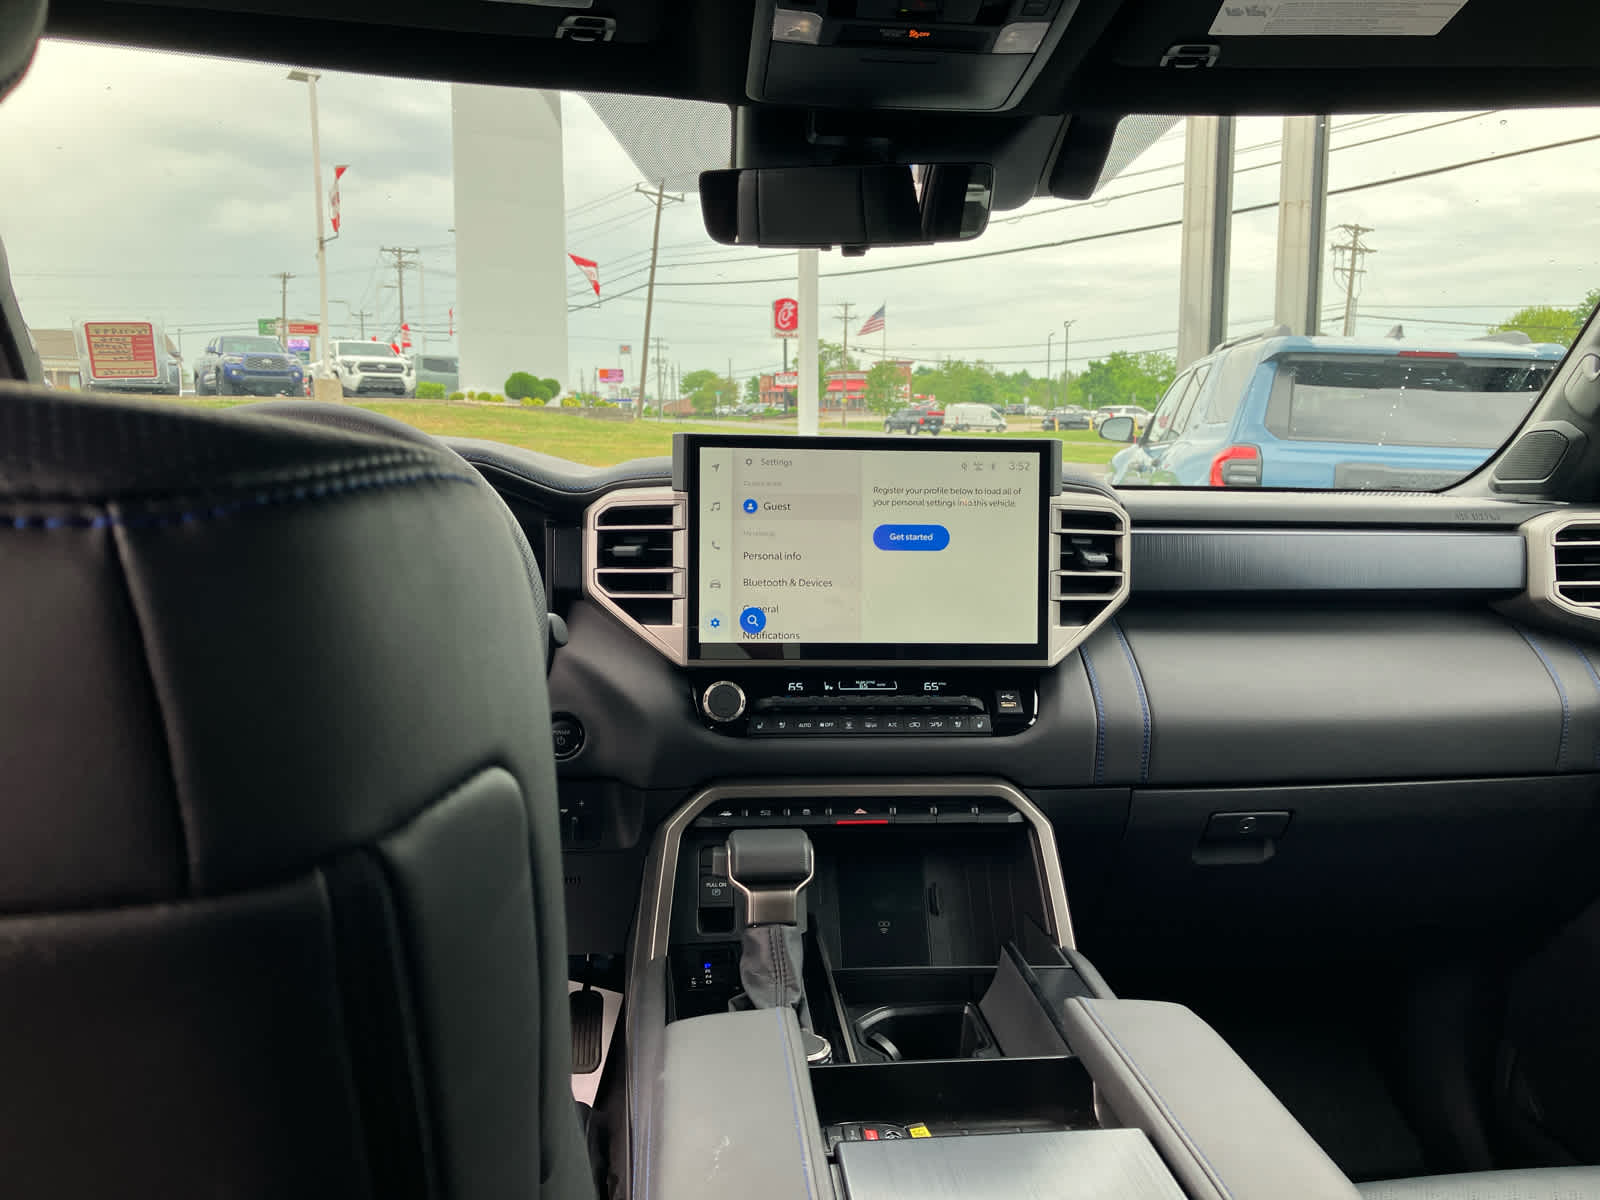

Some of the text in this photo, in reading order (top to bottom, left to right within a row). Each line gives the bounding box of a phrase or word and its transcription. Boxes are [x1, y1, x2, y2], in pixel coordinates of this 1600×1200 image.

[760, 458, 793, 468] Settings
[1008, 462, 1031, 471] 3:52
[873, 486, 904, 496] Register
[905, 487, 922, 496] your
[923, 487, 948, 496] profile
[950, 487, 973, 496] below
[984, 487, 1001, 496] load
[1013, 488, 1022, 496] of
[763, 501, 792, 512] Guest
[872, 499, 890, 508] your
[891, 499, 925, 508] personal
[926, 499, 957, 508] settings
[889, 532, 934, 541] Get started
[743, 551, 802, 561] Personal info
[743, 578, 788, 587] Bluetooth
[798, 578, 833, 588] Devices
[742, 630, 801, 640] Notifications
[788, 682, 804, 691] 65
[923, 682, 939, 691] 65
